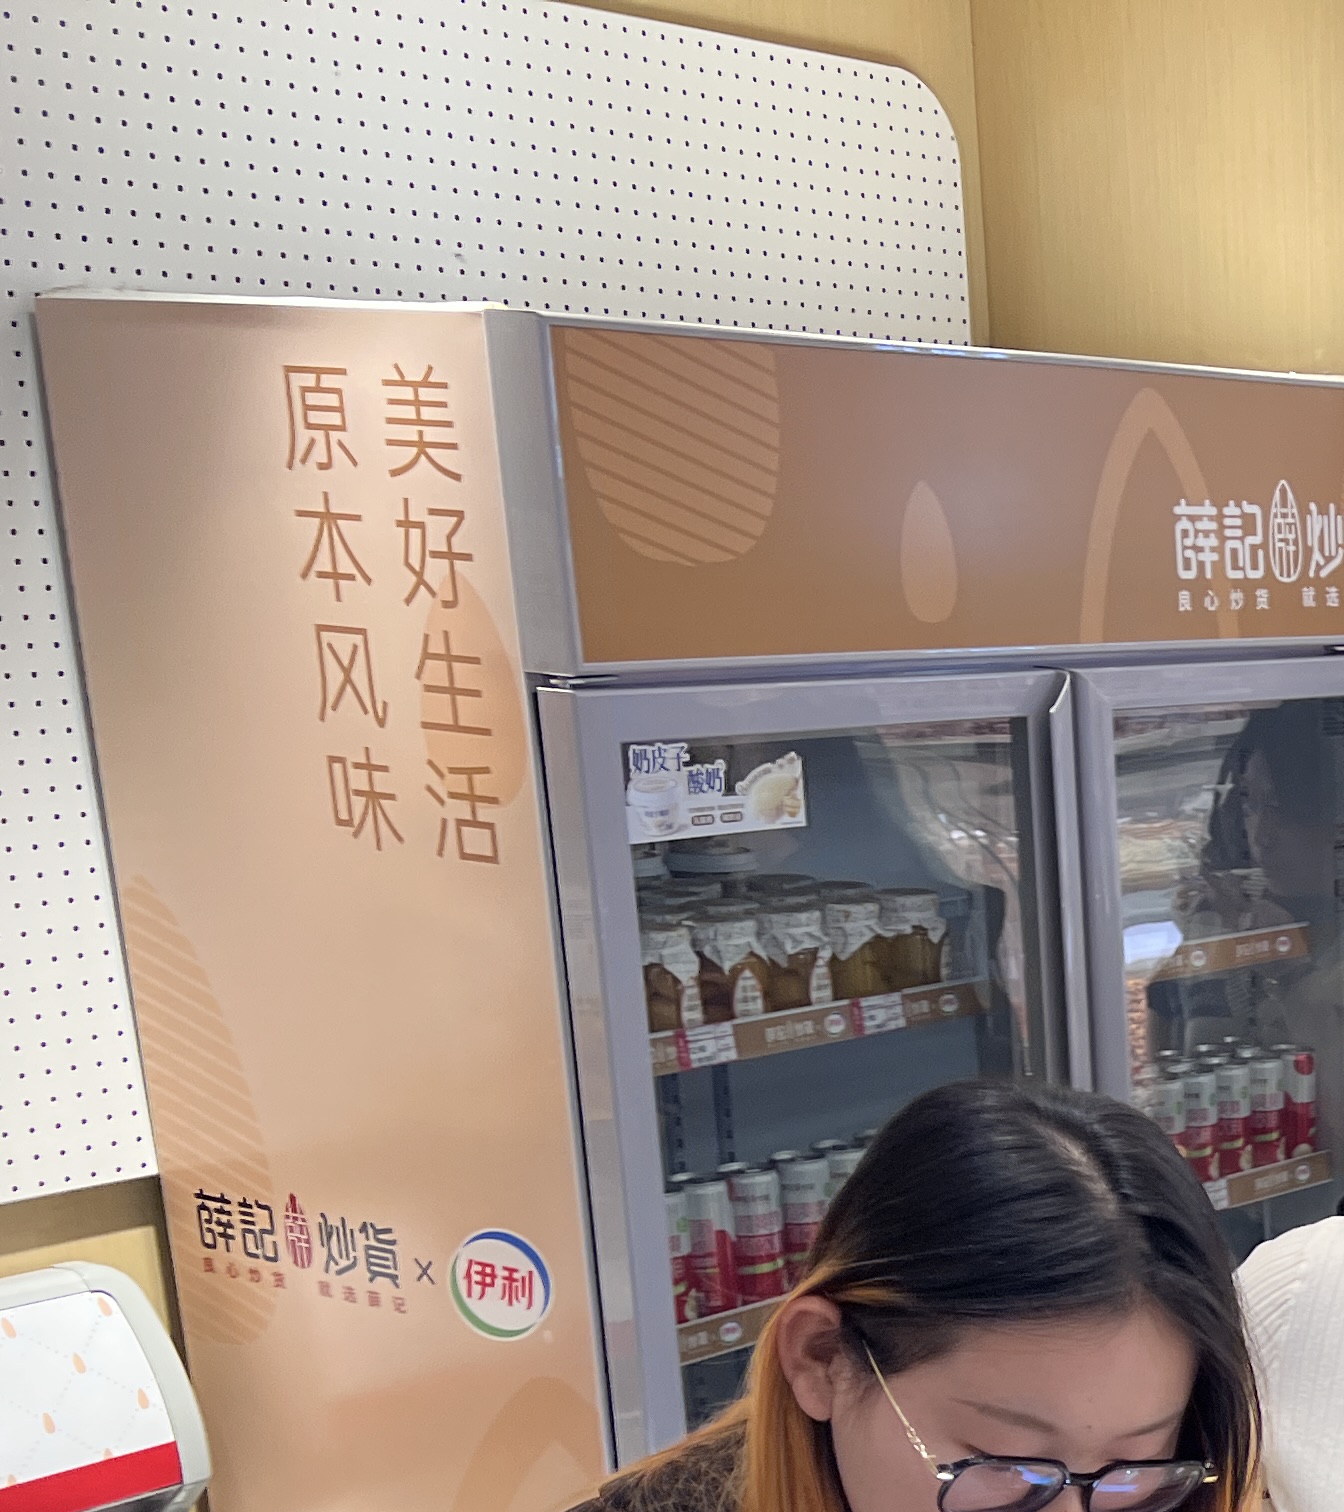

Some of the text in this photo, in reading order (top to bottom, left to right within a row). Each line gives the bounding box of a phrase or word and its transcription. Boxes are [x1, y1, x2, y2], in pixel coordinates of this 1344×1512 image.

[282, 363, 405, 852] 原本风味
[381, 361, 503, 865] 美好生活
[1177, 589, 1271, 611] 良心炒货
[632, 745, 690, 775] 奶皮子
[687, 768, 724, 795] 酸奶
[463, 1257, 536, 1313] 伊利
